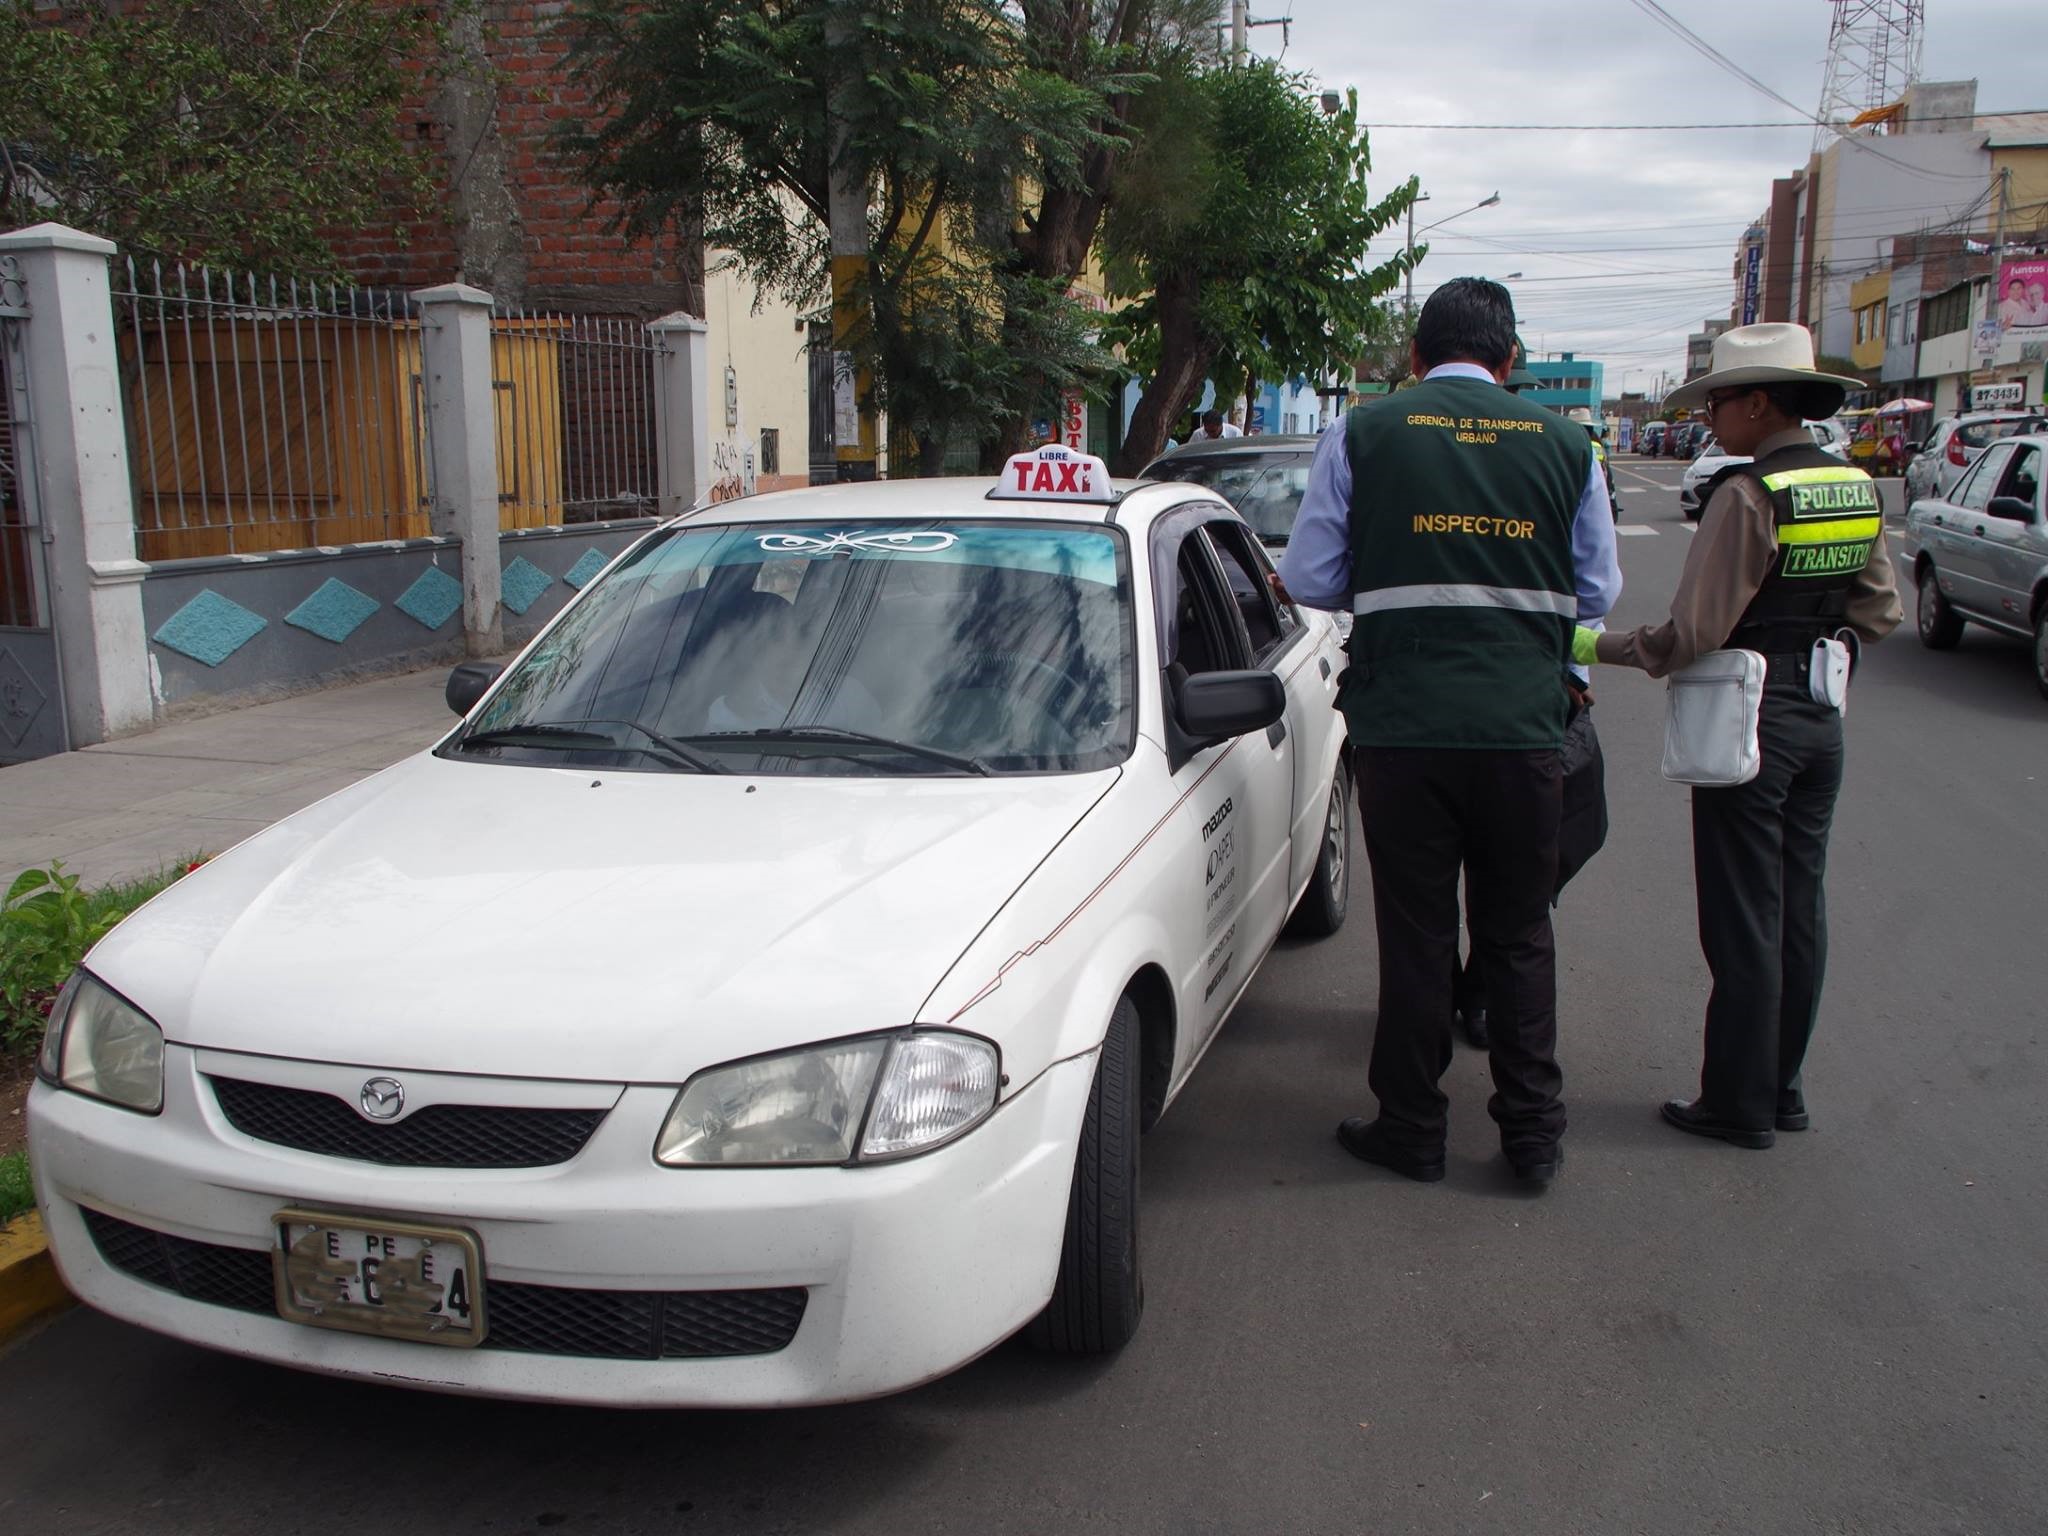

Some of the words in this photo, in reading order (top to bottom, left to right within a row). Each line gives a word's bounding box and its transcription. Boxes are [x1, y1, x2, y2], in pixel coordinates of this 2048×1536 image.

[1746, 248, 1758, 324] IGLESI
[1976, 388, 2019, 401] 27-3434
[1066, 400, 1082, 451] BOT
[1407, 415, 1455, 428] GERENCIA
[1460, 418, 1473, 429] DE
[1478, 419, 1544, 433] TRANSPORTE
[1456, 431, 1497, 444] URBANO
[1039, 452, 1068, 461] LIBRE
[1013, 462, 1092, 493] TAXI
[1798, 485, 1875, 511] POLICIA
[1413, 514, 1536, 539] INSPECTOR
[1791, 543, 1870, 571] TRANSITO
[1202, 797, 1233, 842] mazda
